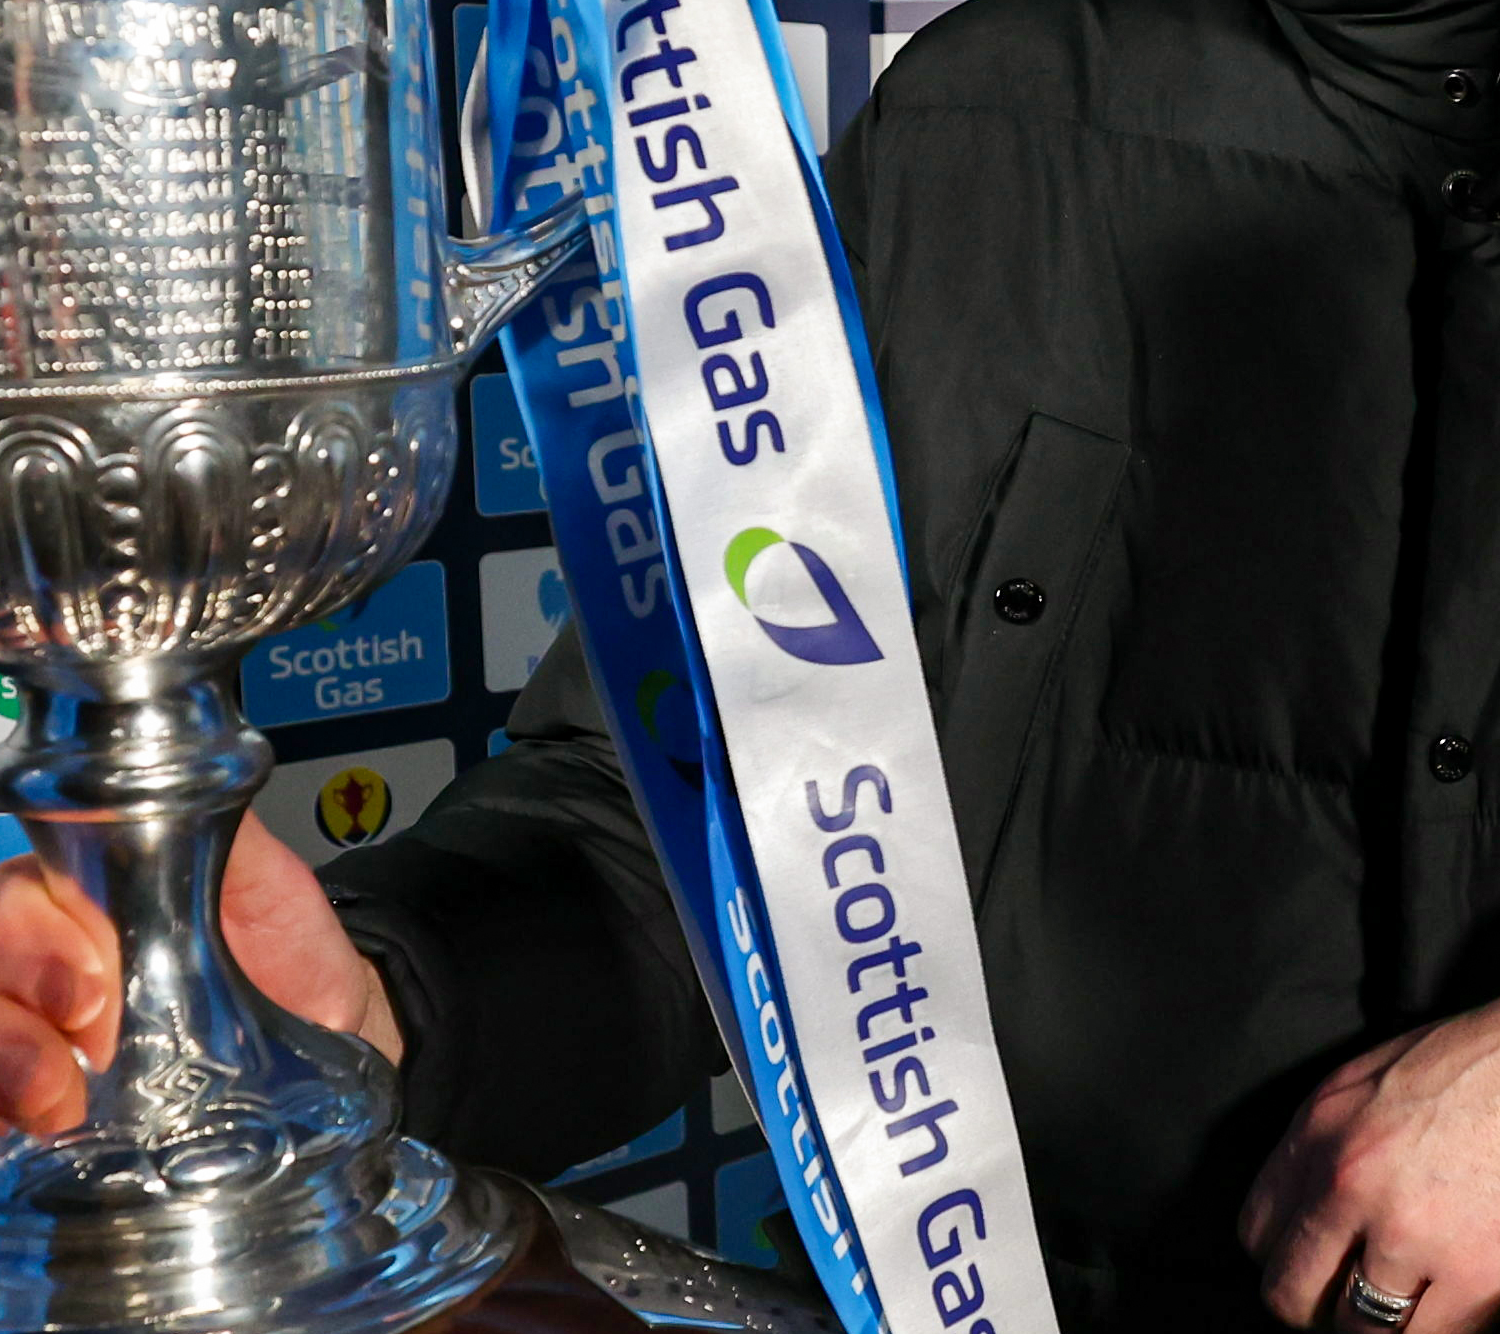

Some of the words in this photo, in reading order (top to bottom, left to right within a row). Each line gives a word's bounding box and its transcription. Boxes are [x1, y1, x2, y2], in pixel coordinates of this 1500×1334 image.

[682, 270, 786, 469] Gas
[587, 429, 672, 619] Gas
[269, 629, 424, 681] Scottish
[313, 674, 384, 710] Gas
[803, 763, 959, 1179] Scottish
